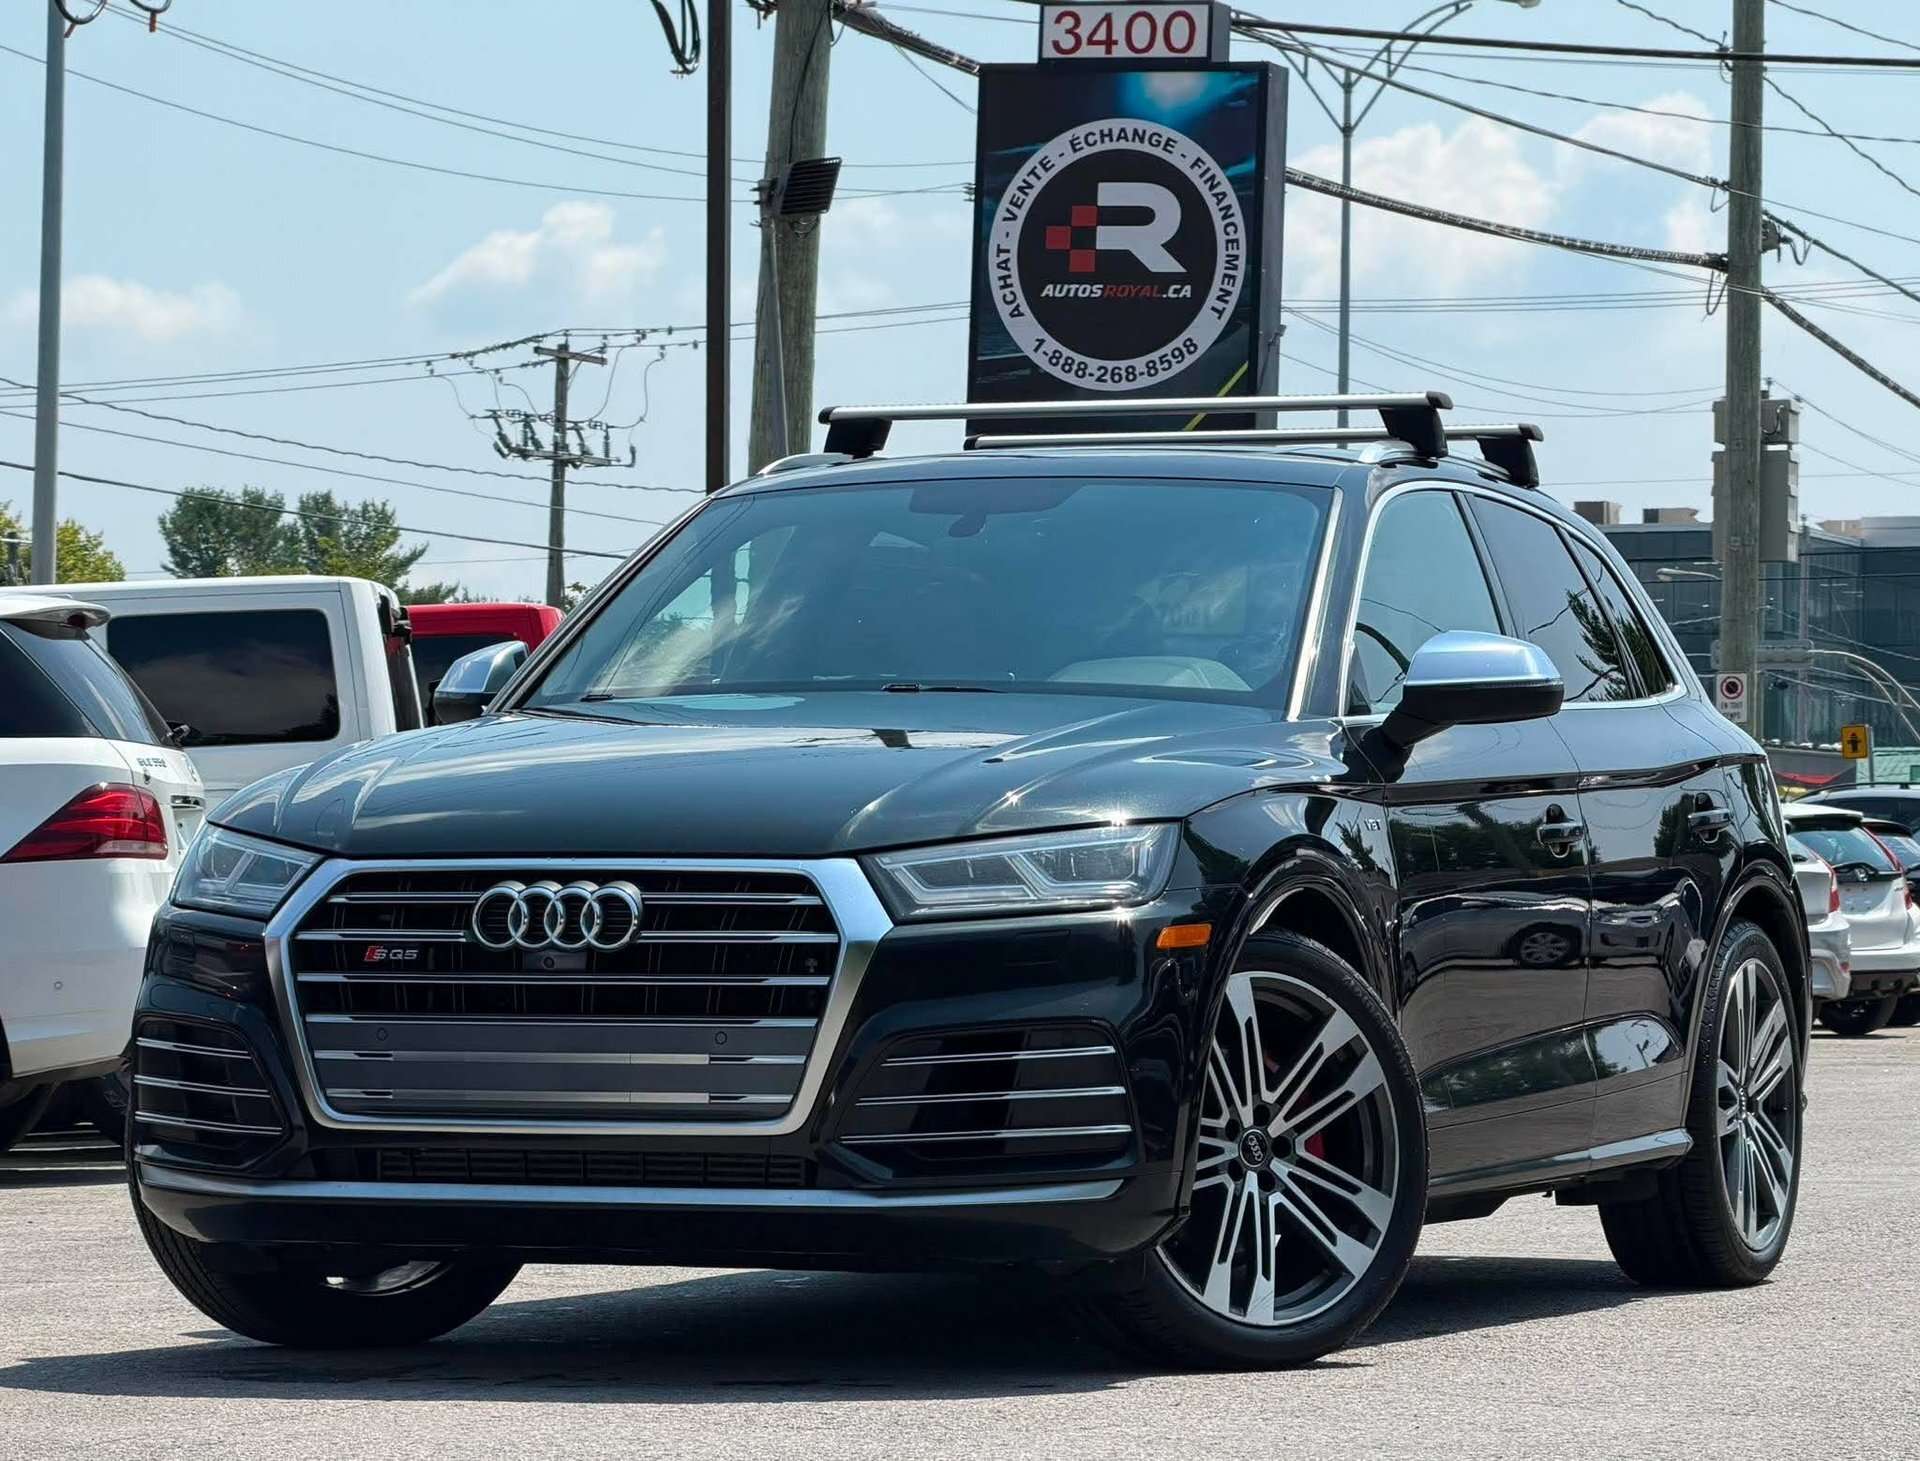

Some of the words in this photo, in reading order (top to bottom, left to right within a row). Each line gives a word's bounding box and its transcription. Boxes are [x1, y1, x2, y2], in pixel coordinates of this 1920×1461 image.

[1051, 10, 1196, 56] 3400
[1069, 126, 1178, 154] ÉCHANGE
[1002, 155, 1056, 222] VENTE
[1096, 182, 1188, 273] R
[1189, 157, 1240, 321] FINANCEMENT
[996, 243, 1025, 318] ACHAT
[1040, 284, 1192, 298] AUTOSROYAL.CA
[1032, 337, 1199, 383] 1-888-268-8598
[369, 948, 418, 960] SQ5
